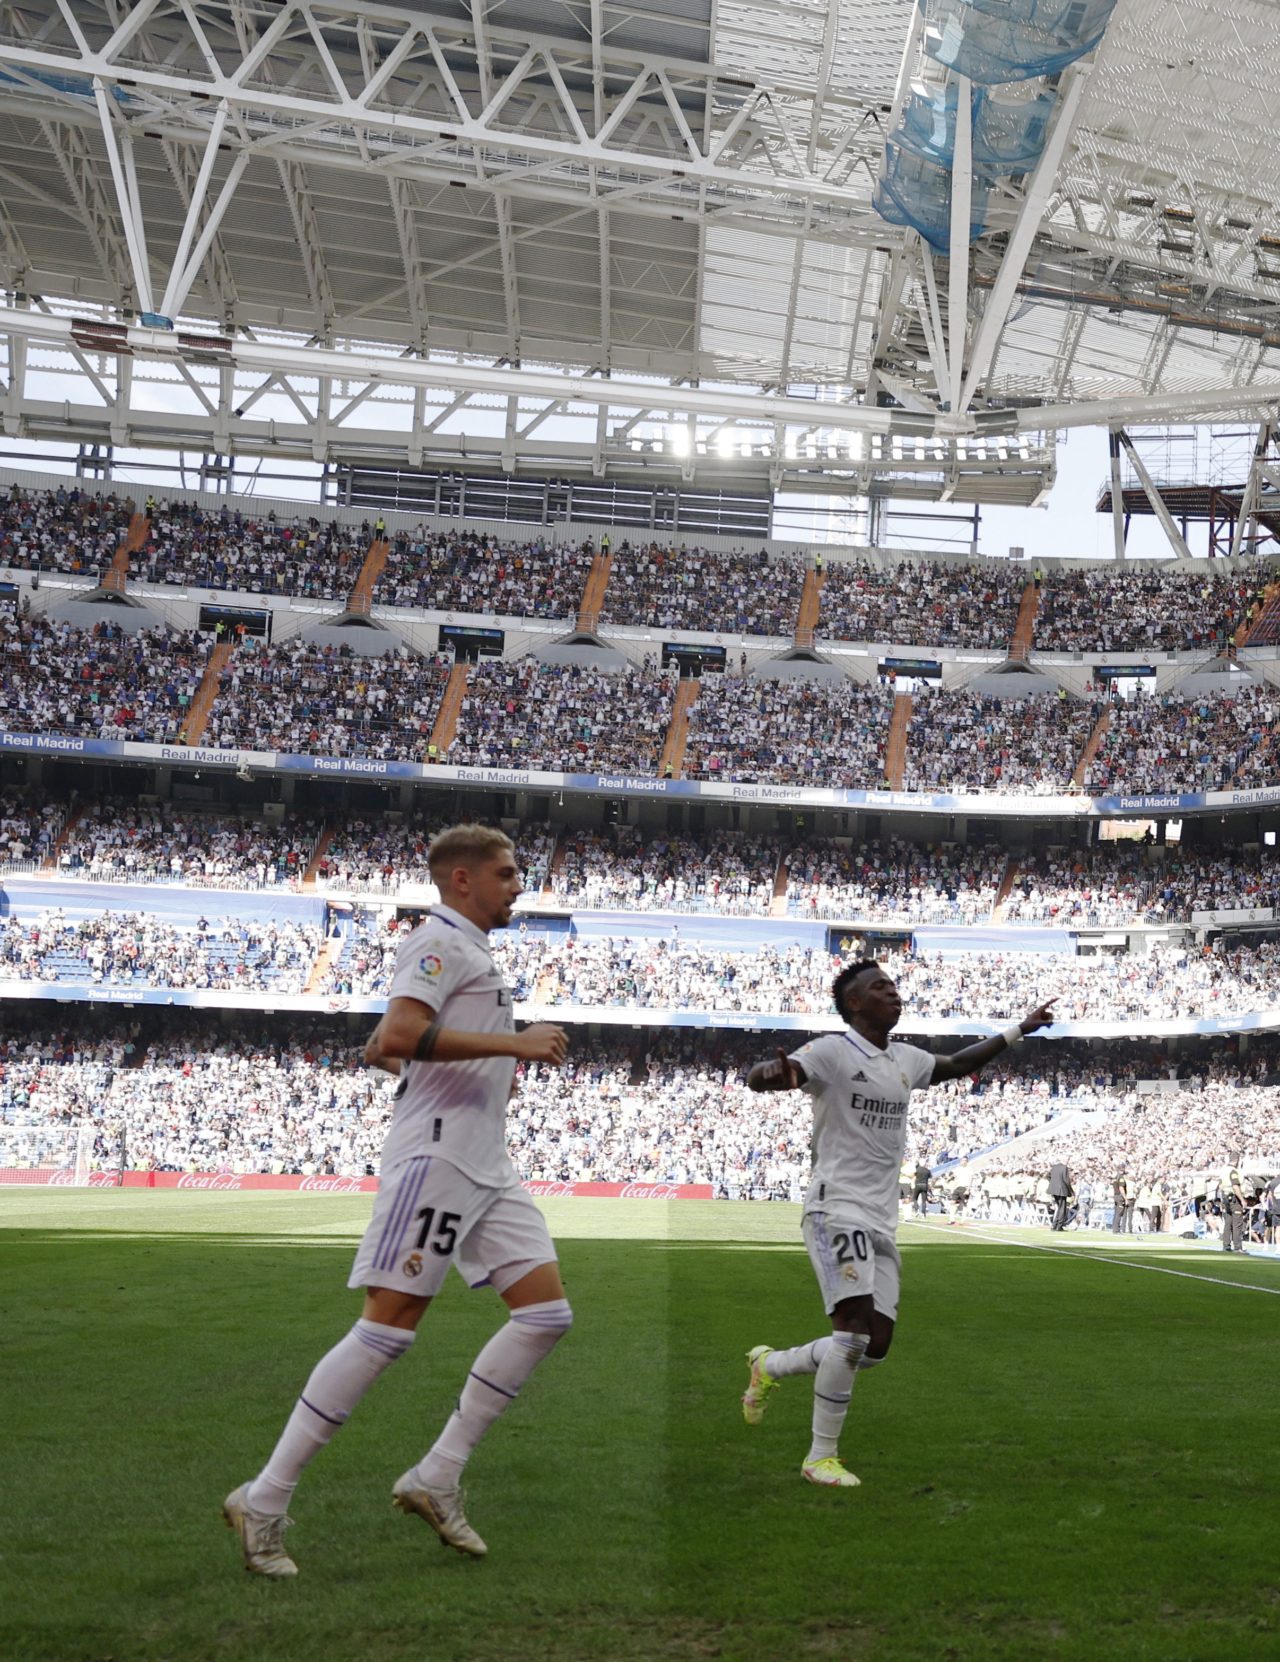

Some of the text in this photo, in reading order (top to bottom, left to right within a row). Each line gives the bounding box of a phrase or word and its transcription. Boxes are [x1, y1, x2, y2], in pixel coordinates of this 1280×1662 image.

[3, 734, 84, 750] Real Madrid
[161, 748, 239, 763] Real Madrid
[314, 758, 387, 773] Real Madrid
[457, 770, 530, 784] Real Madrid
[598, 777, 666, 791] Real Madrid
[733, 787, 802, 799] Real Madrid
[1232, 793, 1253, 803] Real
[1120, 797, 1179, 808] Real Madrid
[415, 1206, 462, 1256] 15
[832, 1229, 868, 1263] 20
